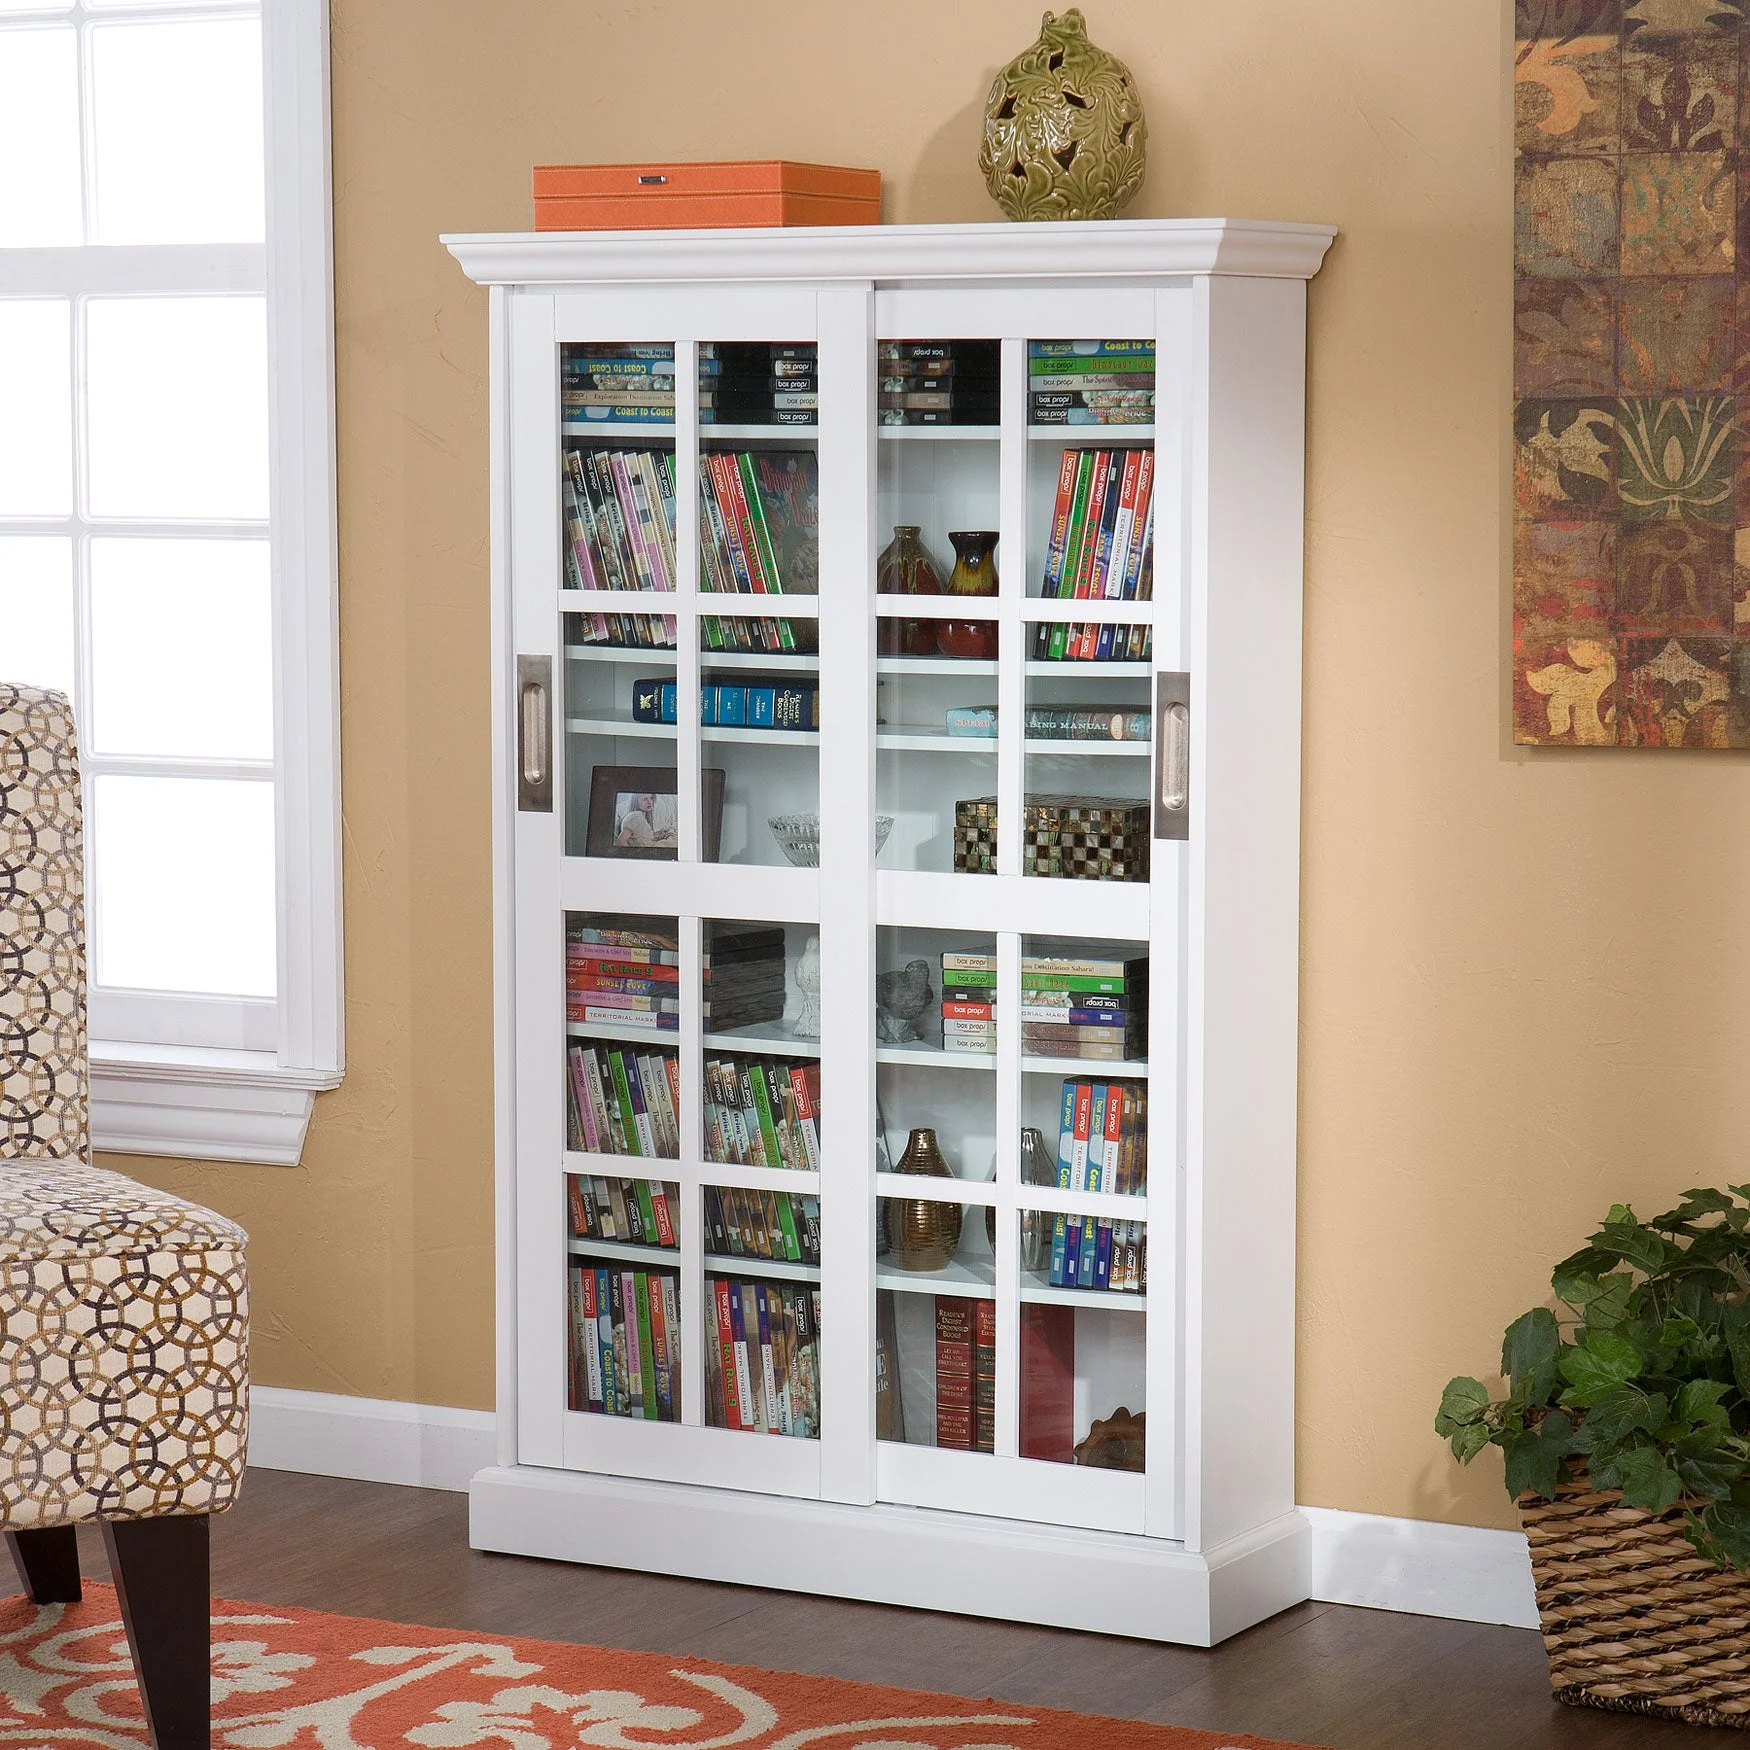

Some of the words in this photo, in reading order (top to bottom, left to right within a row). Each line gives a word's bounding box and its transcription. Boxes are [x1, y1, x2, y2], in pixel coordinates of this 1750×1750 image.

[780, 362, 791, 370] box
[616, 407, 638, 416] Coast
[640, 407, 648, 416] to
[650, 408, 674, 416] Coast
[1100, 467, 1108, 481] box
[1060, 722, 1108, 730] MANUAL
[596, 979, 622, 988] SUNSET
[642, 1070, 650, 1082] box
[768, 1070, 776, 1084] box
[1066, 1093, 1074, 1106] box
[942, 1330, 962, 1338] BOOKS
[724, 1343, 732, 1364] RAT
[604, 1350, 612, 1374] Coast
[606, 1377, 612, 1387] to
[726, 1368, 734, 1395] RACE
[606, 1390, 615, 1414] Coast
[728, 1398, 736, 1407] 9
